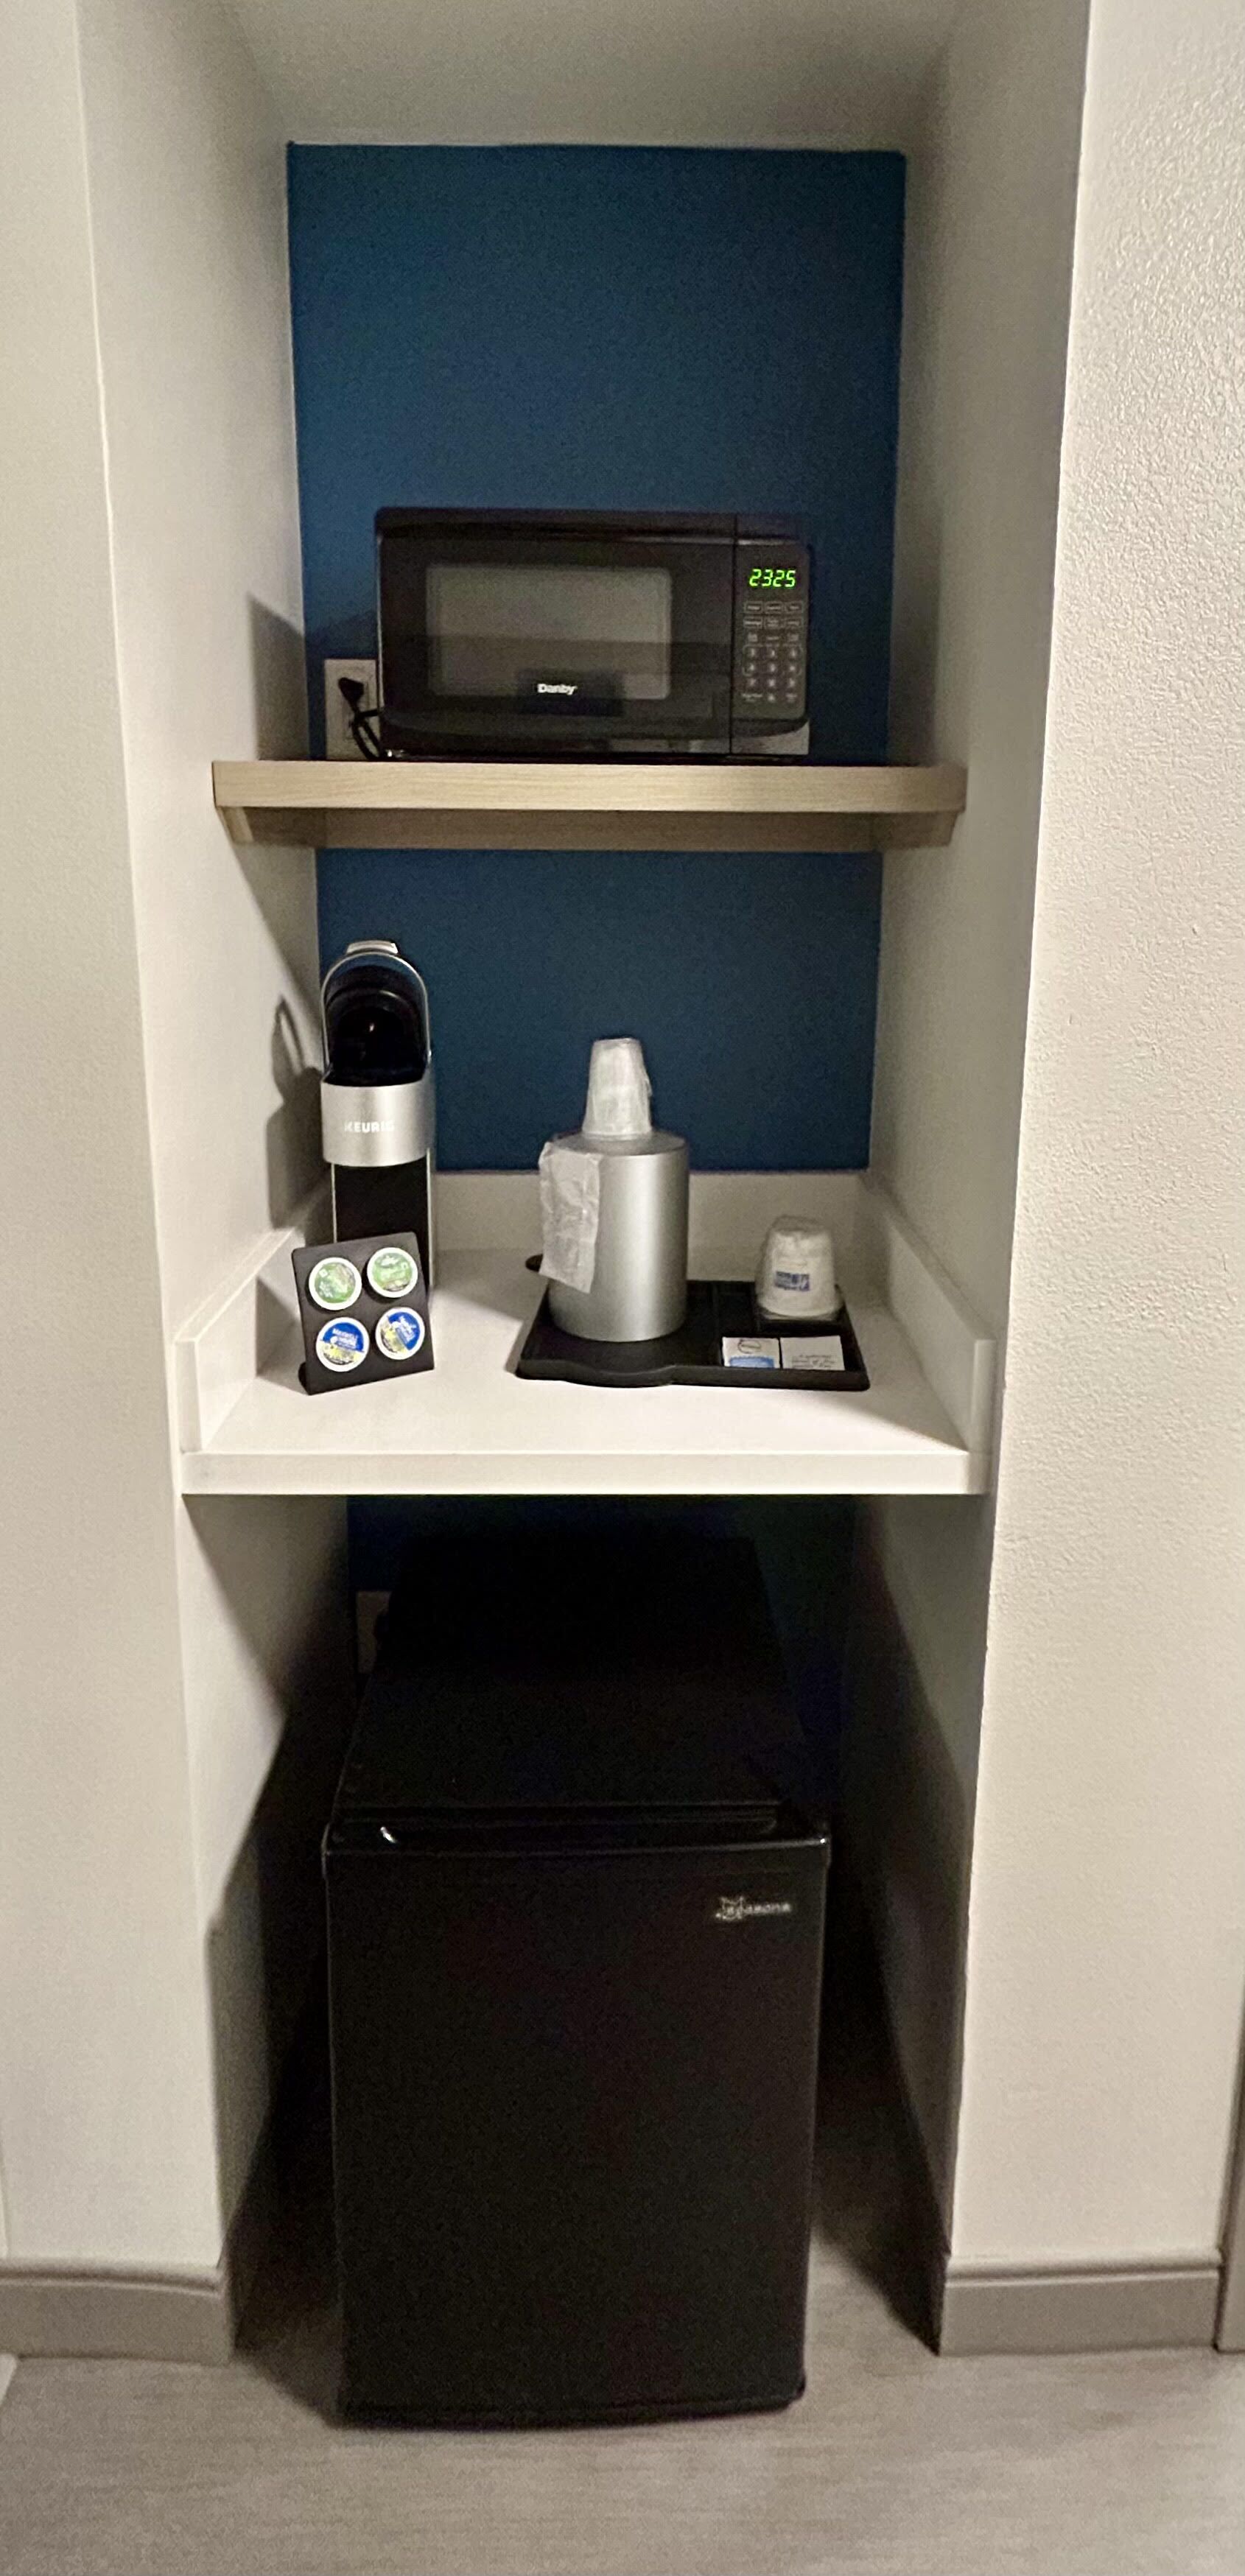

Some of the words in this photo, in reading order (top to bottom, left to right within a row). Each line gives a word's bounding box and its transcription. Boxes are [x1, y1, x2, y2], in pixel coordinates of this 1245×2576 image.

[748, 568, 796, 588] 2325
[537, 683, 578, 695] Danby
[344, 1120, 395, 1133] KEURIG
